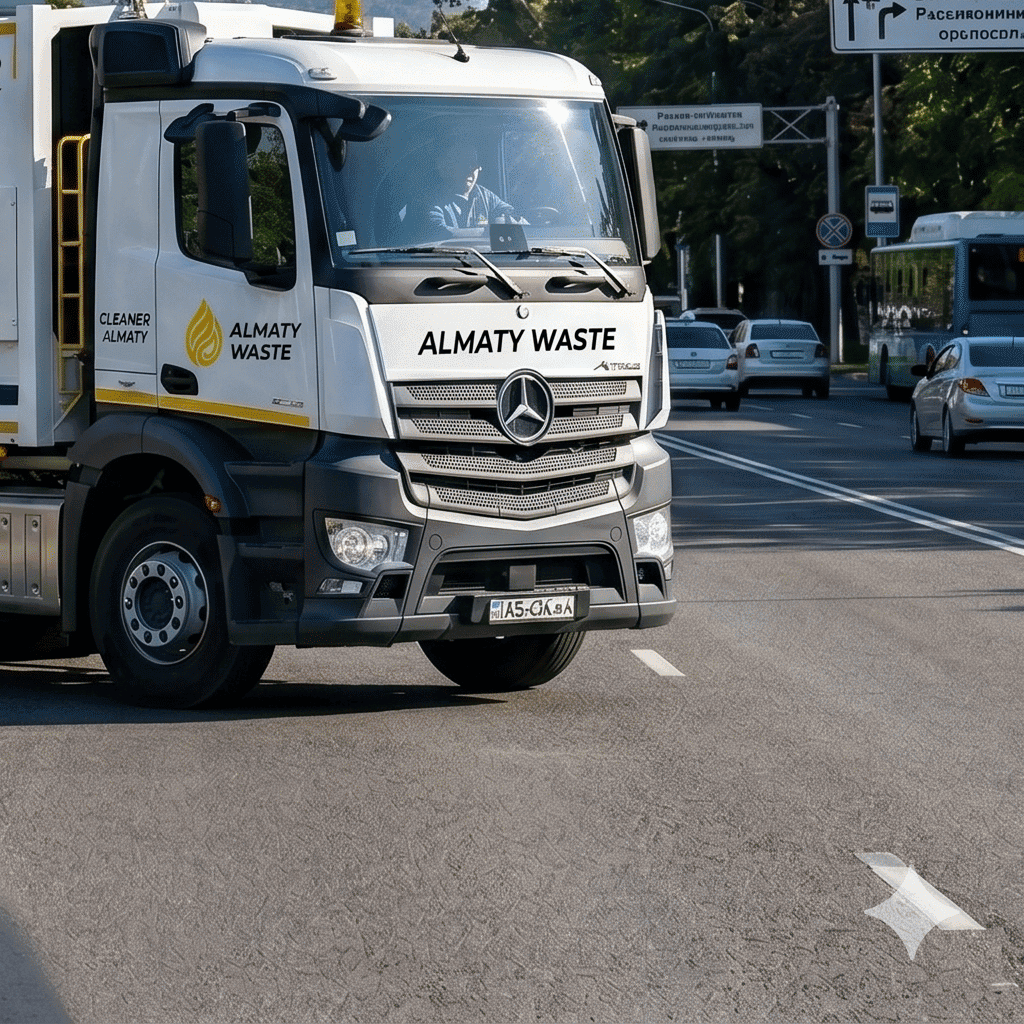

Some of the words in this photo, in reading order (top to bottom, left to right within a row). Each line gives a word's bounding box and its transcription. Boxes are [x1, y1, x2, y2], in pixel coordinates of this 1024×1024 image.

[99, 312, 151, 326] CLEANER
[102, 330, 149, 343] ALMATY
[229, 322, 302, 339] ALMATY
[417, 329, 525, 355] ALMATY
[531, 328, 617, 352] WASTE
[230, 344, 292, 360] WASTE
